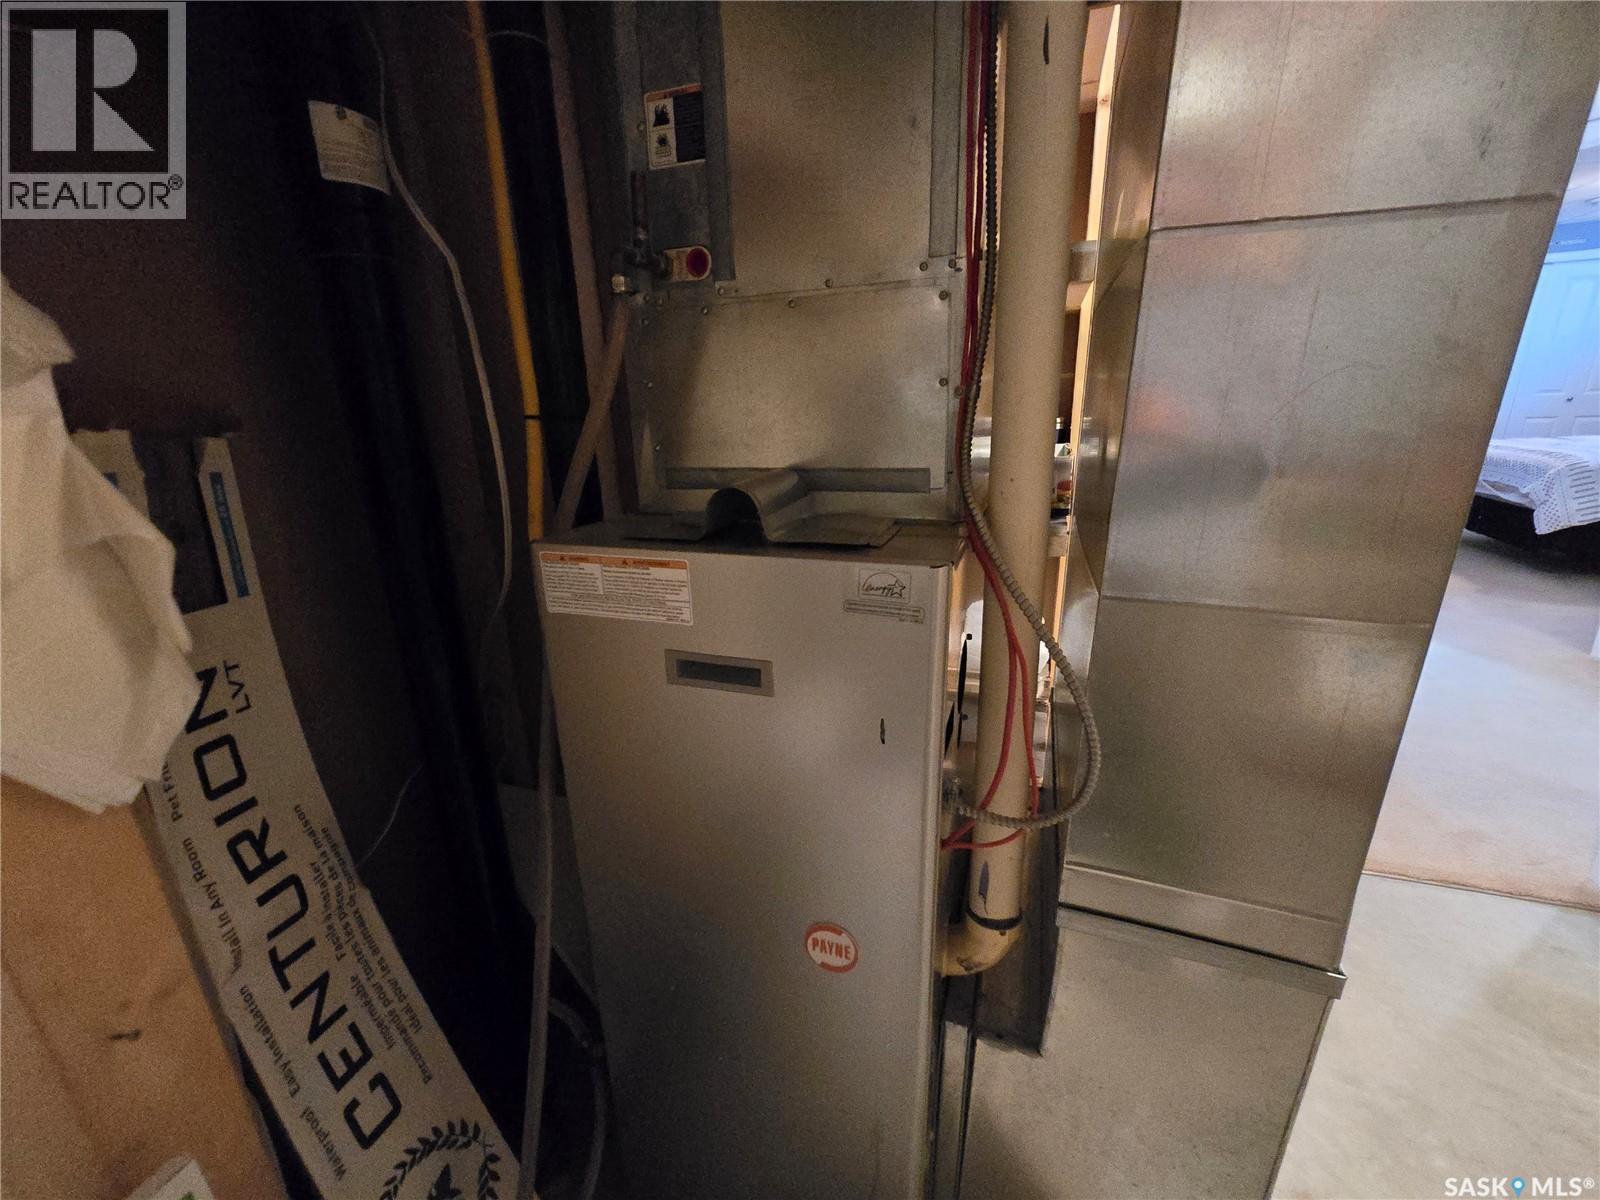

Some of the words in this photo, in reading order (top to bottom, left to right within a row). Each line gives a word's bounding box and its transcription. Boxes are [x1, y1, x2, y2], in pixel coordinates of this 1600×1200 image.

[224, 659, 251, 713] LVT
[166, 793, 182, 822] Pet
[293, 803, 322, 849] maison
[180, 836, 206, 882] Room
[319, 850, 330, 864] la
[326, 865, 338, 879] de
[184, 667, 402, 1150] CENTURION
[201, 882, 224, 909] Any
[217, 910, 231, 927] In
[342, 922, 354, 943] les
[353, 907, 380, 955] animaux
[221, 927, 241, 974] Install
[324, 922, 347, 961] Facile
[811, 937, 851, 961] PAYNE
[351, 940, 374, 981] toutes
[377, 955, 390, 978] les
[371, 982, 393, 1007] pour
[388, 977, 408, 1003] pour
[238, 984, 283, 1065] Installation
[351, 974, 395, 1049] Imperméable
[400, 1002, 422, 1034] Idéal
[279, 1060, 300, 1097] Easy
[299, 1106, 345, 1181] Waterproof
